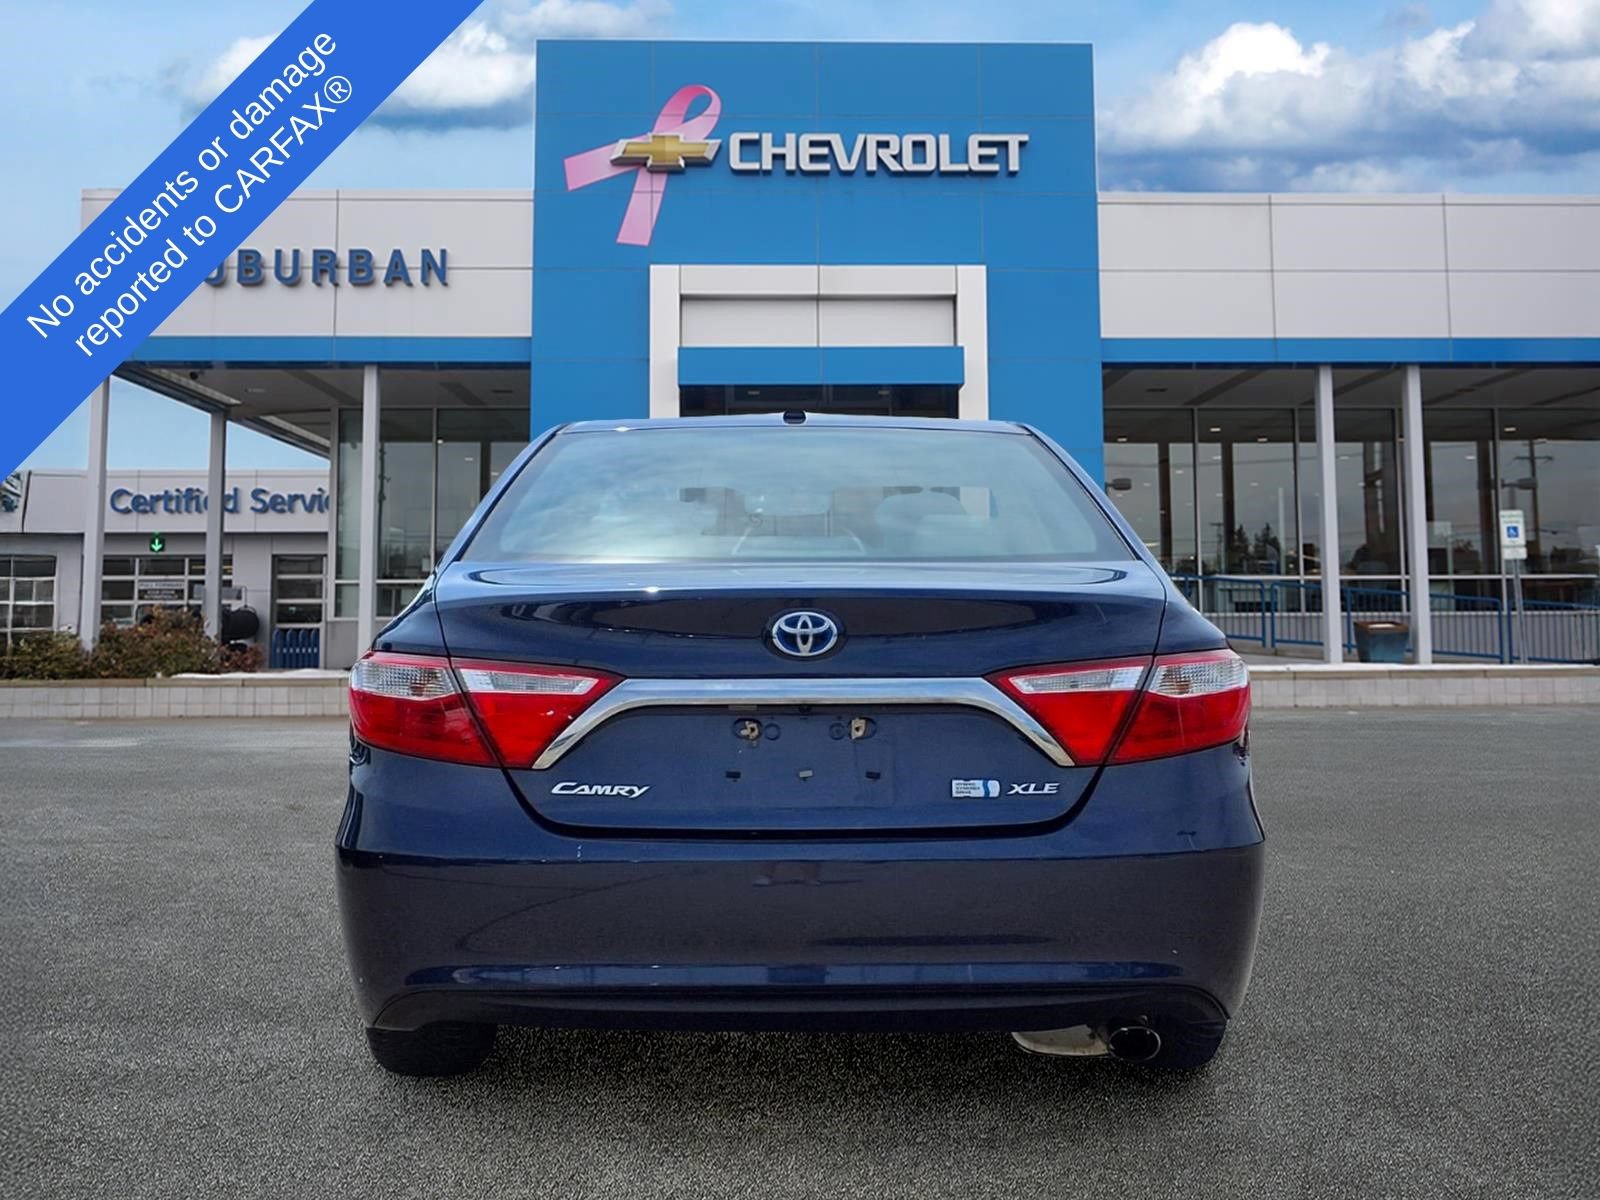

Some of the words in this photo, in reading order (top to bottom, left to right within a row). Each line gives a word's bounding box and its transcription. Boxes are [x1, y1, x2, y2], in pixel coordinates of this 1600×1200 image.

[729, 132, 1029, 174] CHEVROLET
[204, 248, 448, 287] BURBAN
[110, 487, 240, 515] Certifid
[250, 487, 330, 515] Servi
[551, 781, 651, 799] CAMRY
[1006, 782, 1060, 795] XLE
